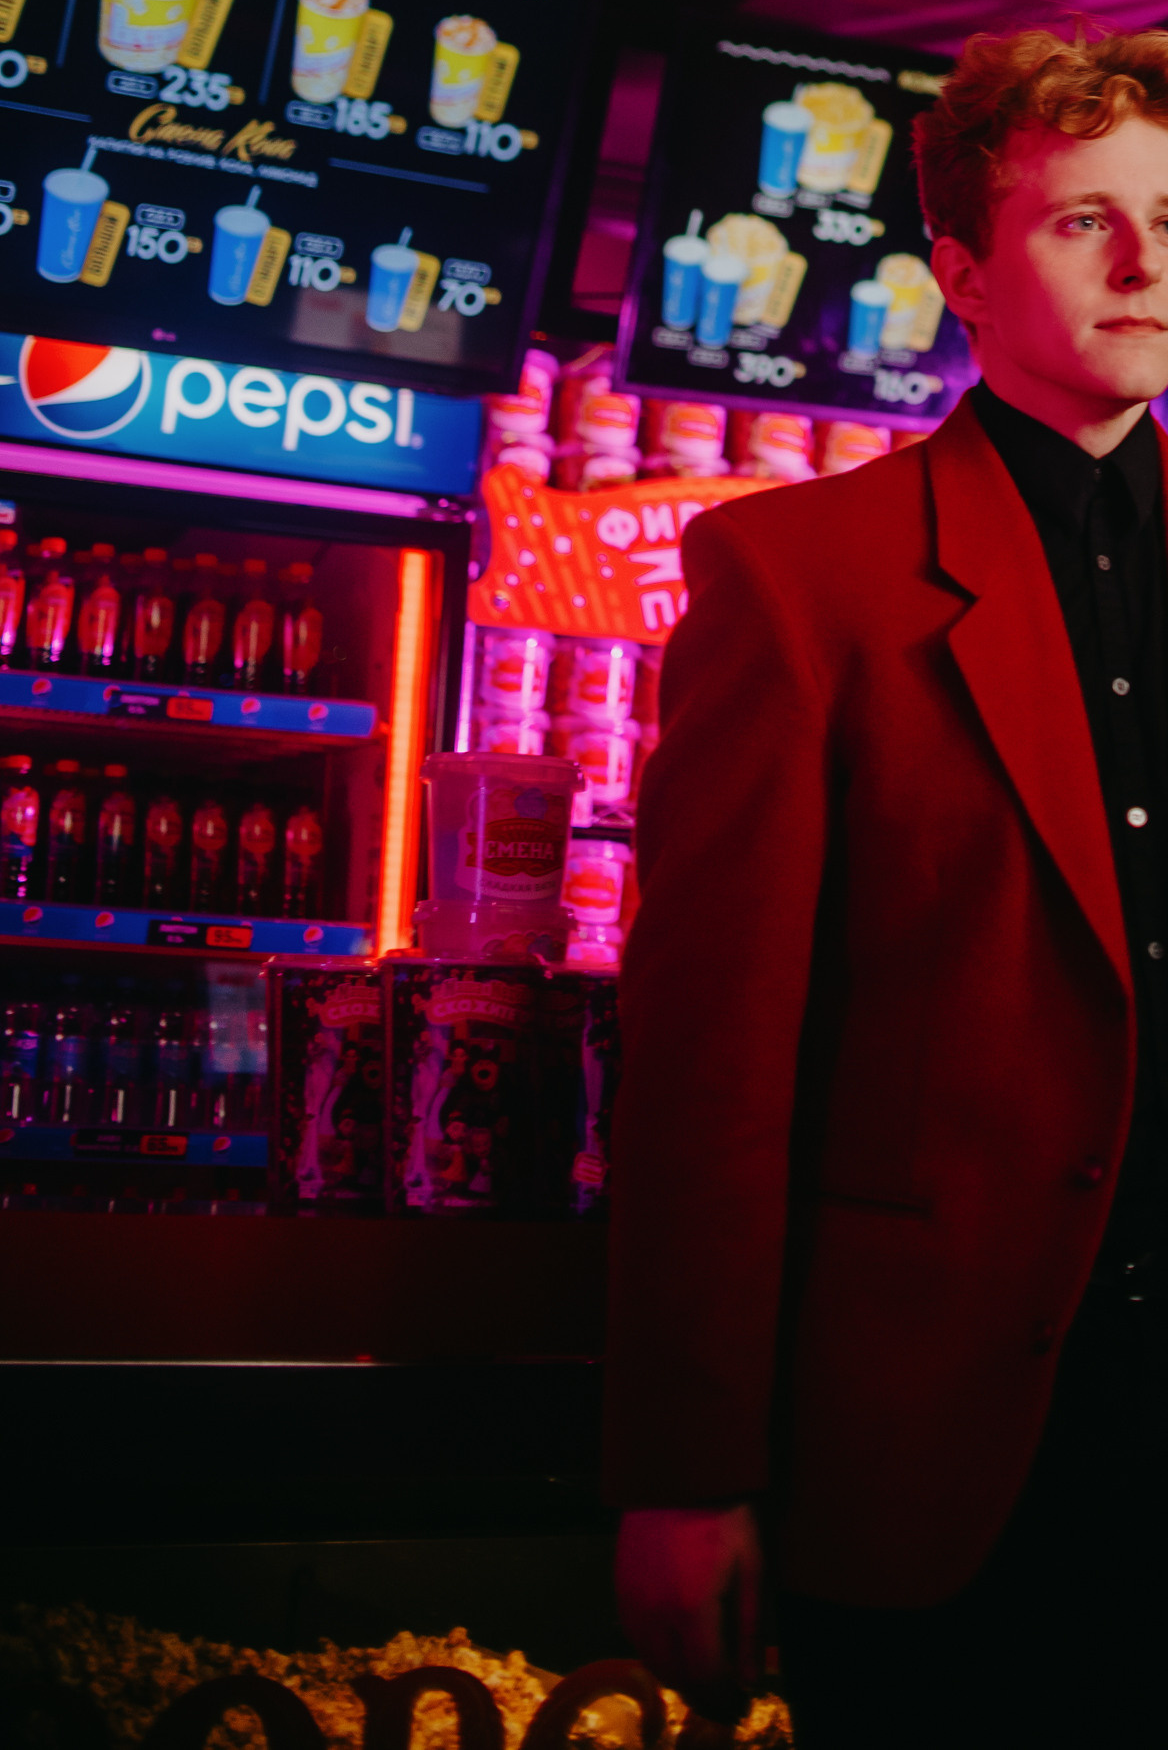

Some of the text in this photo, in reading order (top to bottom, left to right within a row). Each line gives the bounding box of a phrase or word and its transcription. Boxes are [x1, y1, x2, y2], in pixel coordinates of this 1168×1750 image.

[158, 64, 232, 112] 235
[335, 96, 393, 140] 185
[464, 119, 523, 162] 110
[126, 223, 189, 264] 150
[289, 253, 341, 292] 110
[437, 278, 486, 316] 70
[160, 357, 415, 452] pepsi
